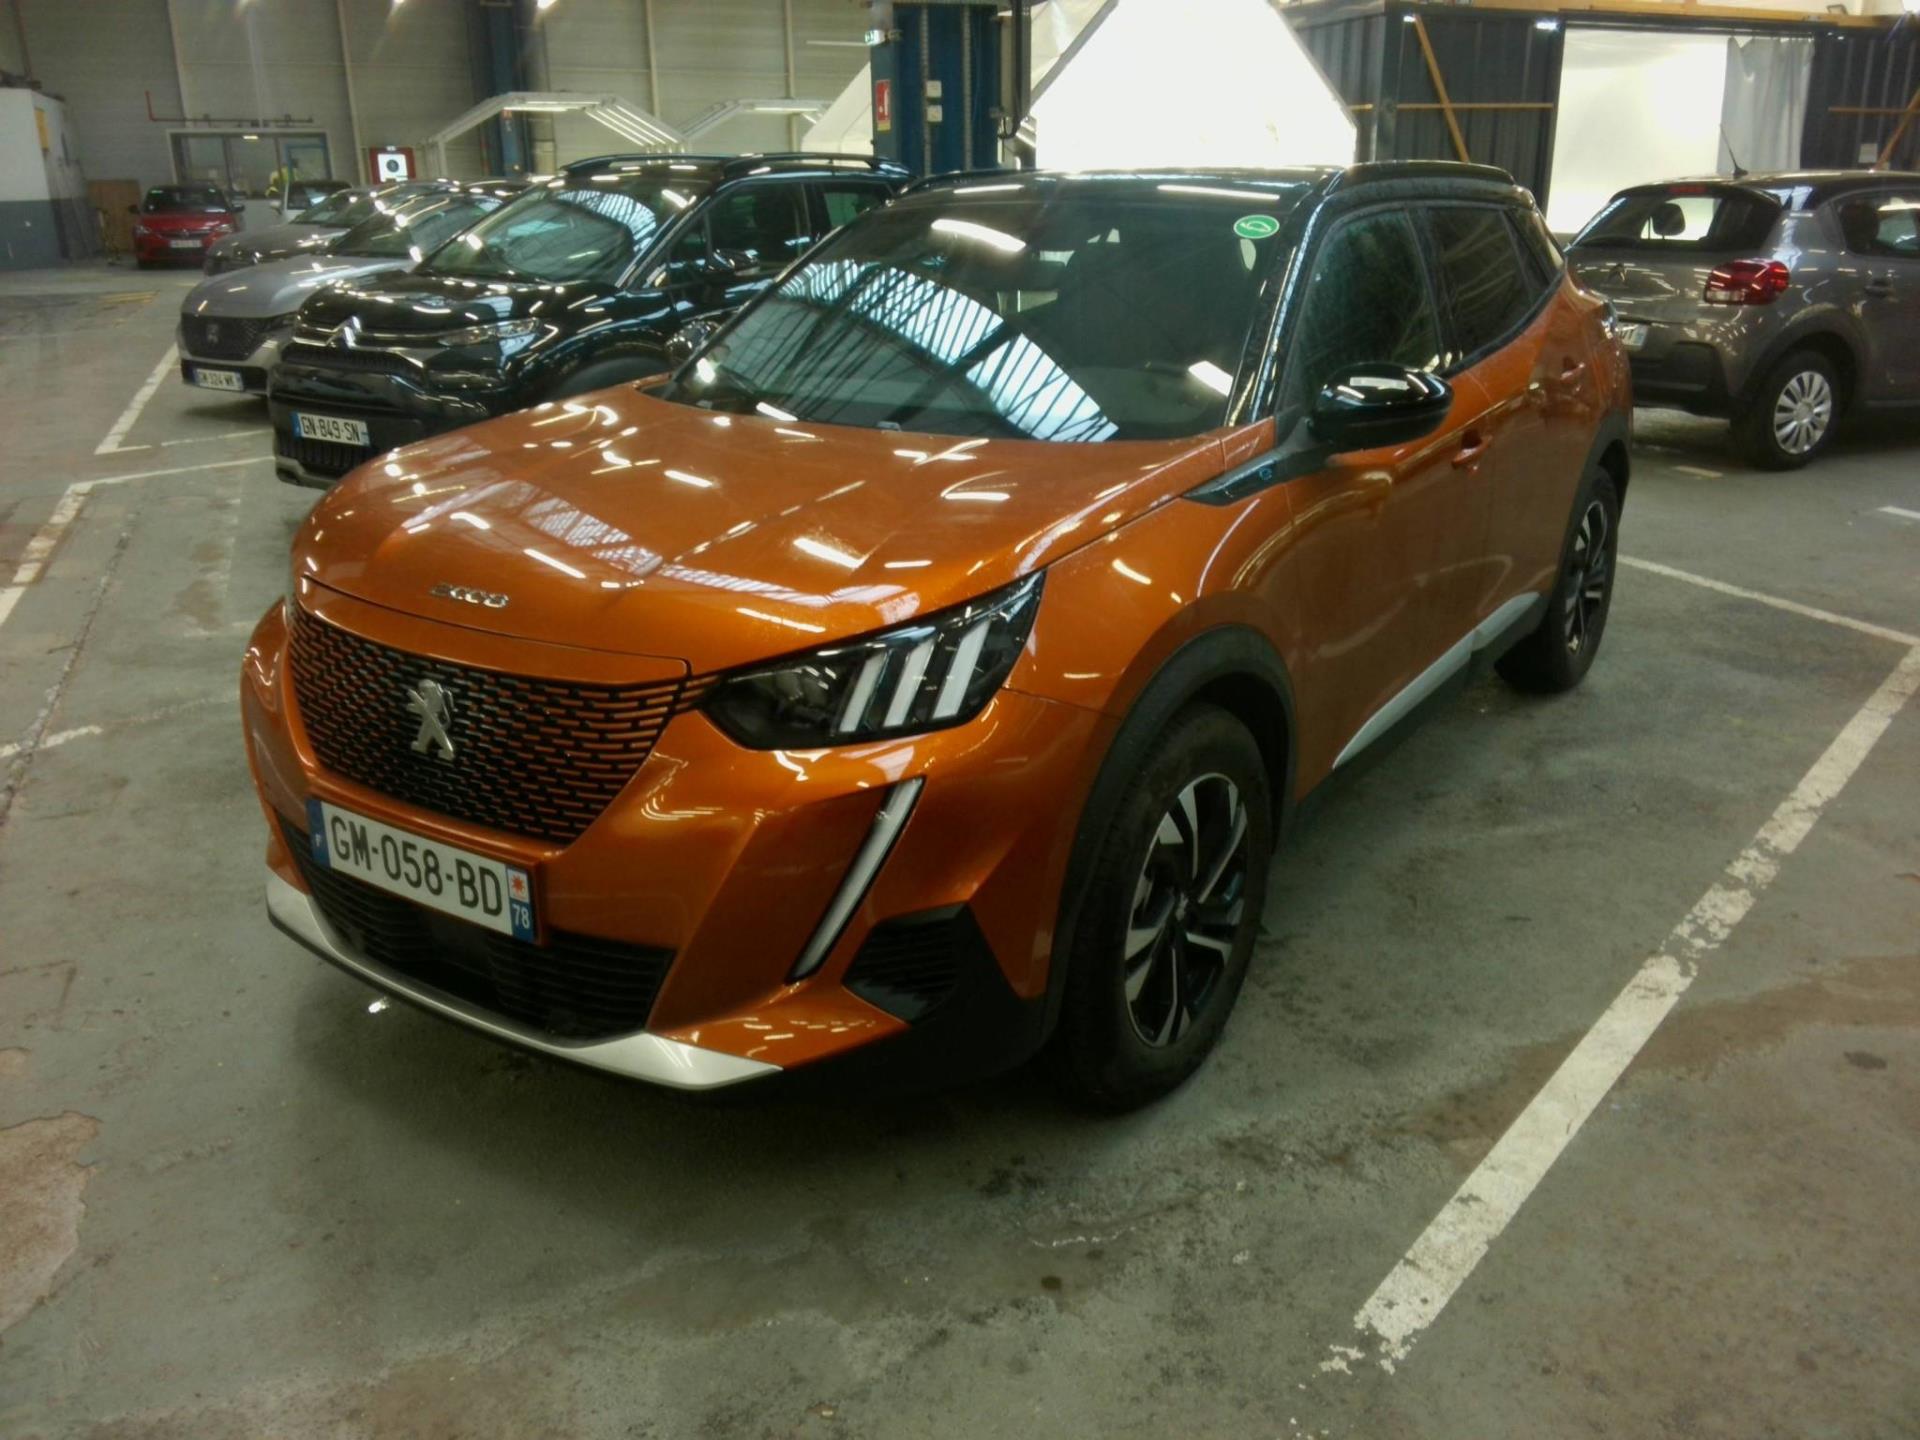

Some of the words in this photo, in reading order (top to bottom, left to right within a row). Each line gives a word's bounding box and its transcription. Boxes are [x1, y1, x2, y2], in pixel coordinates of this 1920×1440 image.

[301, 416, 361, 441] GN-849-SN
[331, 815, 502, 917] GM-058-BD
[513, 904, 530, 930] 78
